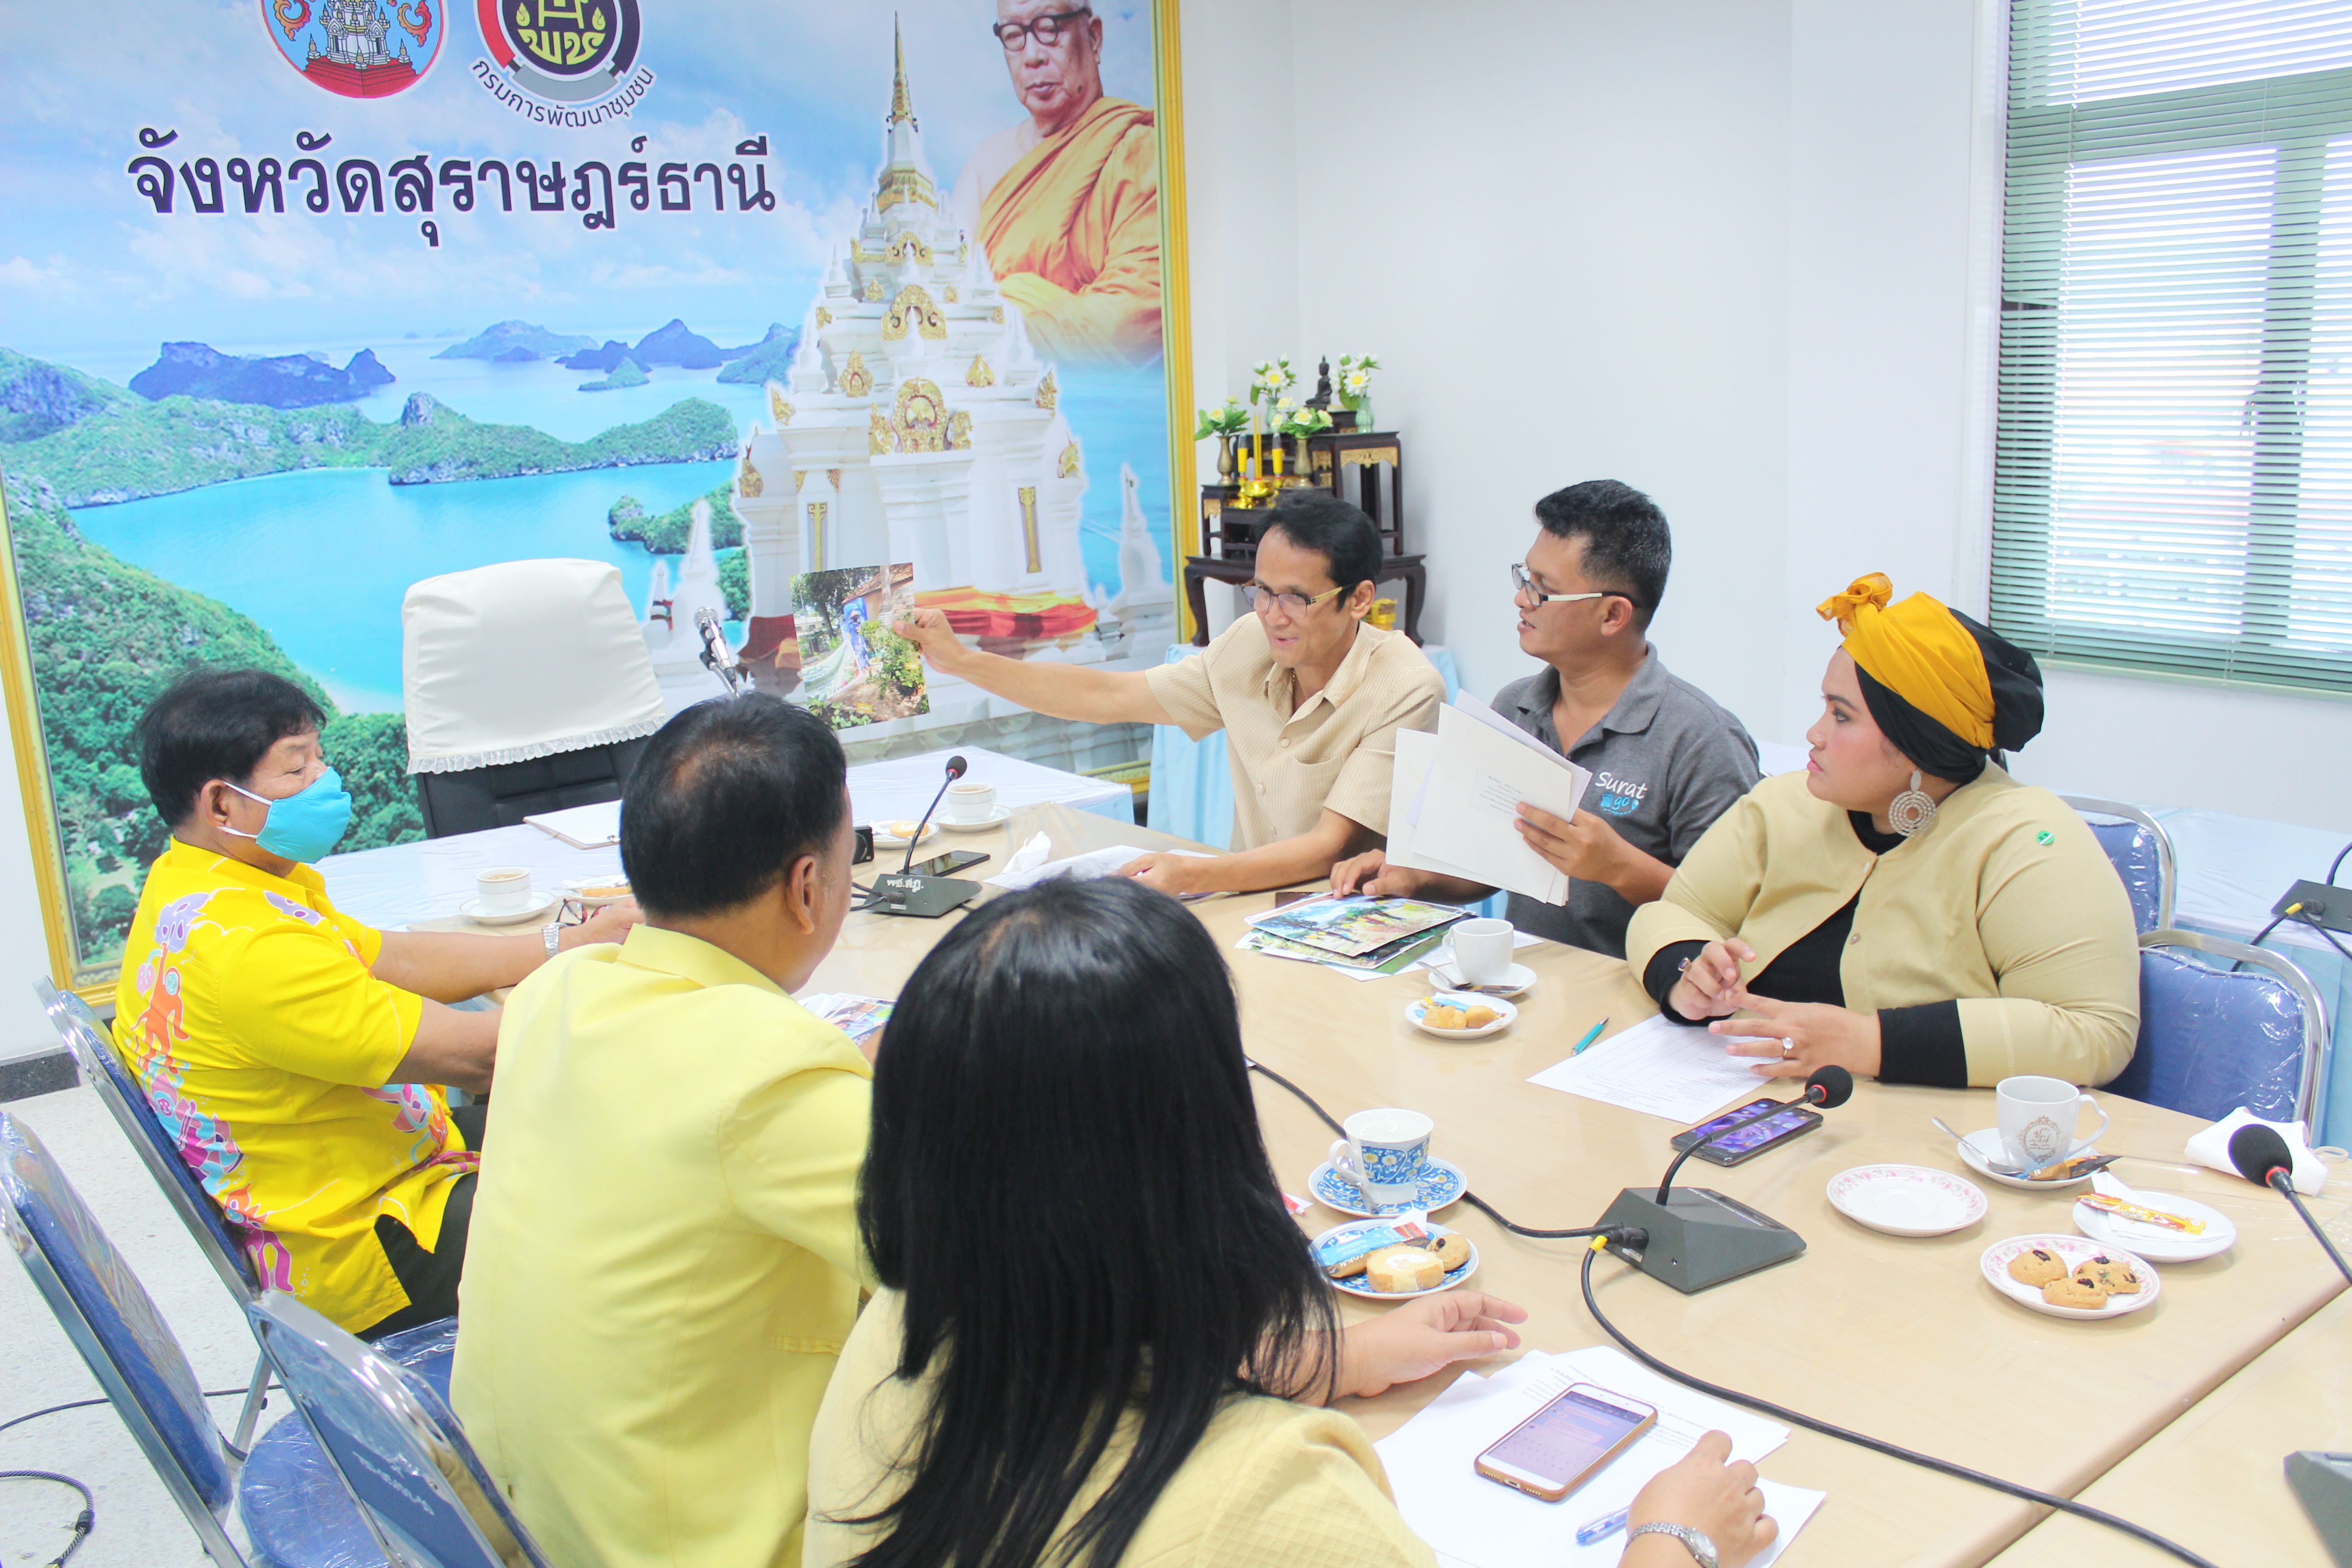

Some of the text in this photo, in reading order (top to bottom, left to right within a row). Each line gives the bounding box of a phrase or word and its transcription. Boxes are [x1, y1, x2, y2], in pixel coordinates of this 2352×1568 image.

[473, 61, 654, 127] กรมการพัฒนาชุมชน
[128, 128, 775, 245] จังหวัดสุราษฎร์ธานี
[1595, 772, 1648, 799] Surat
[1612, 797, 1630, 811] go
